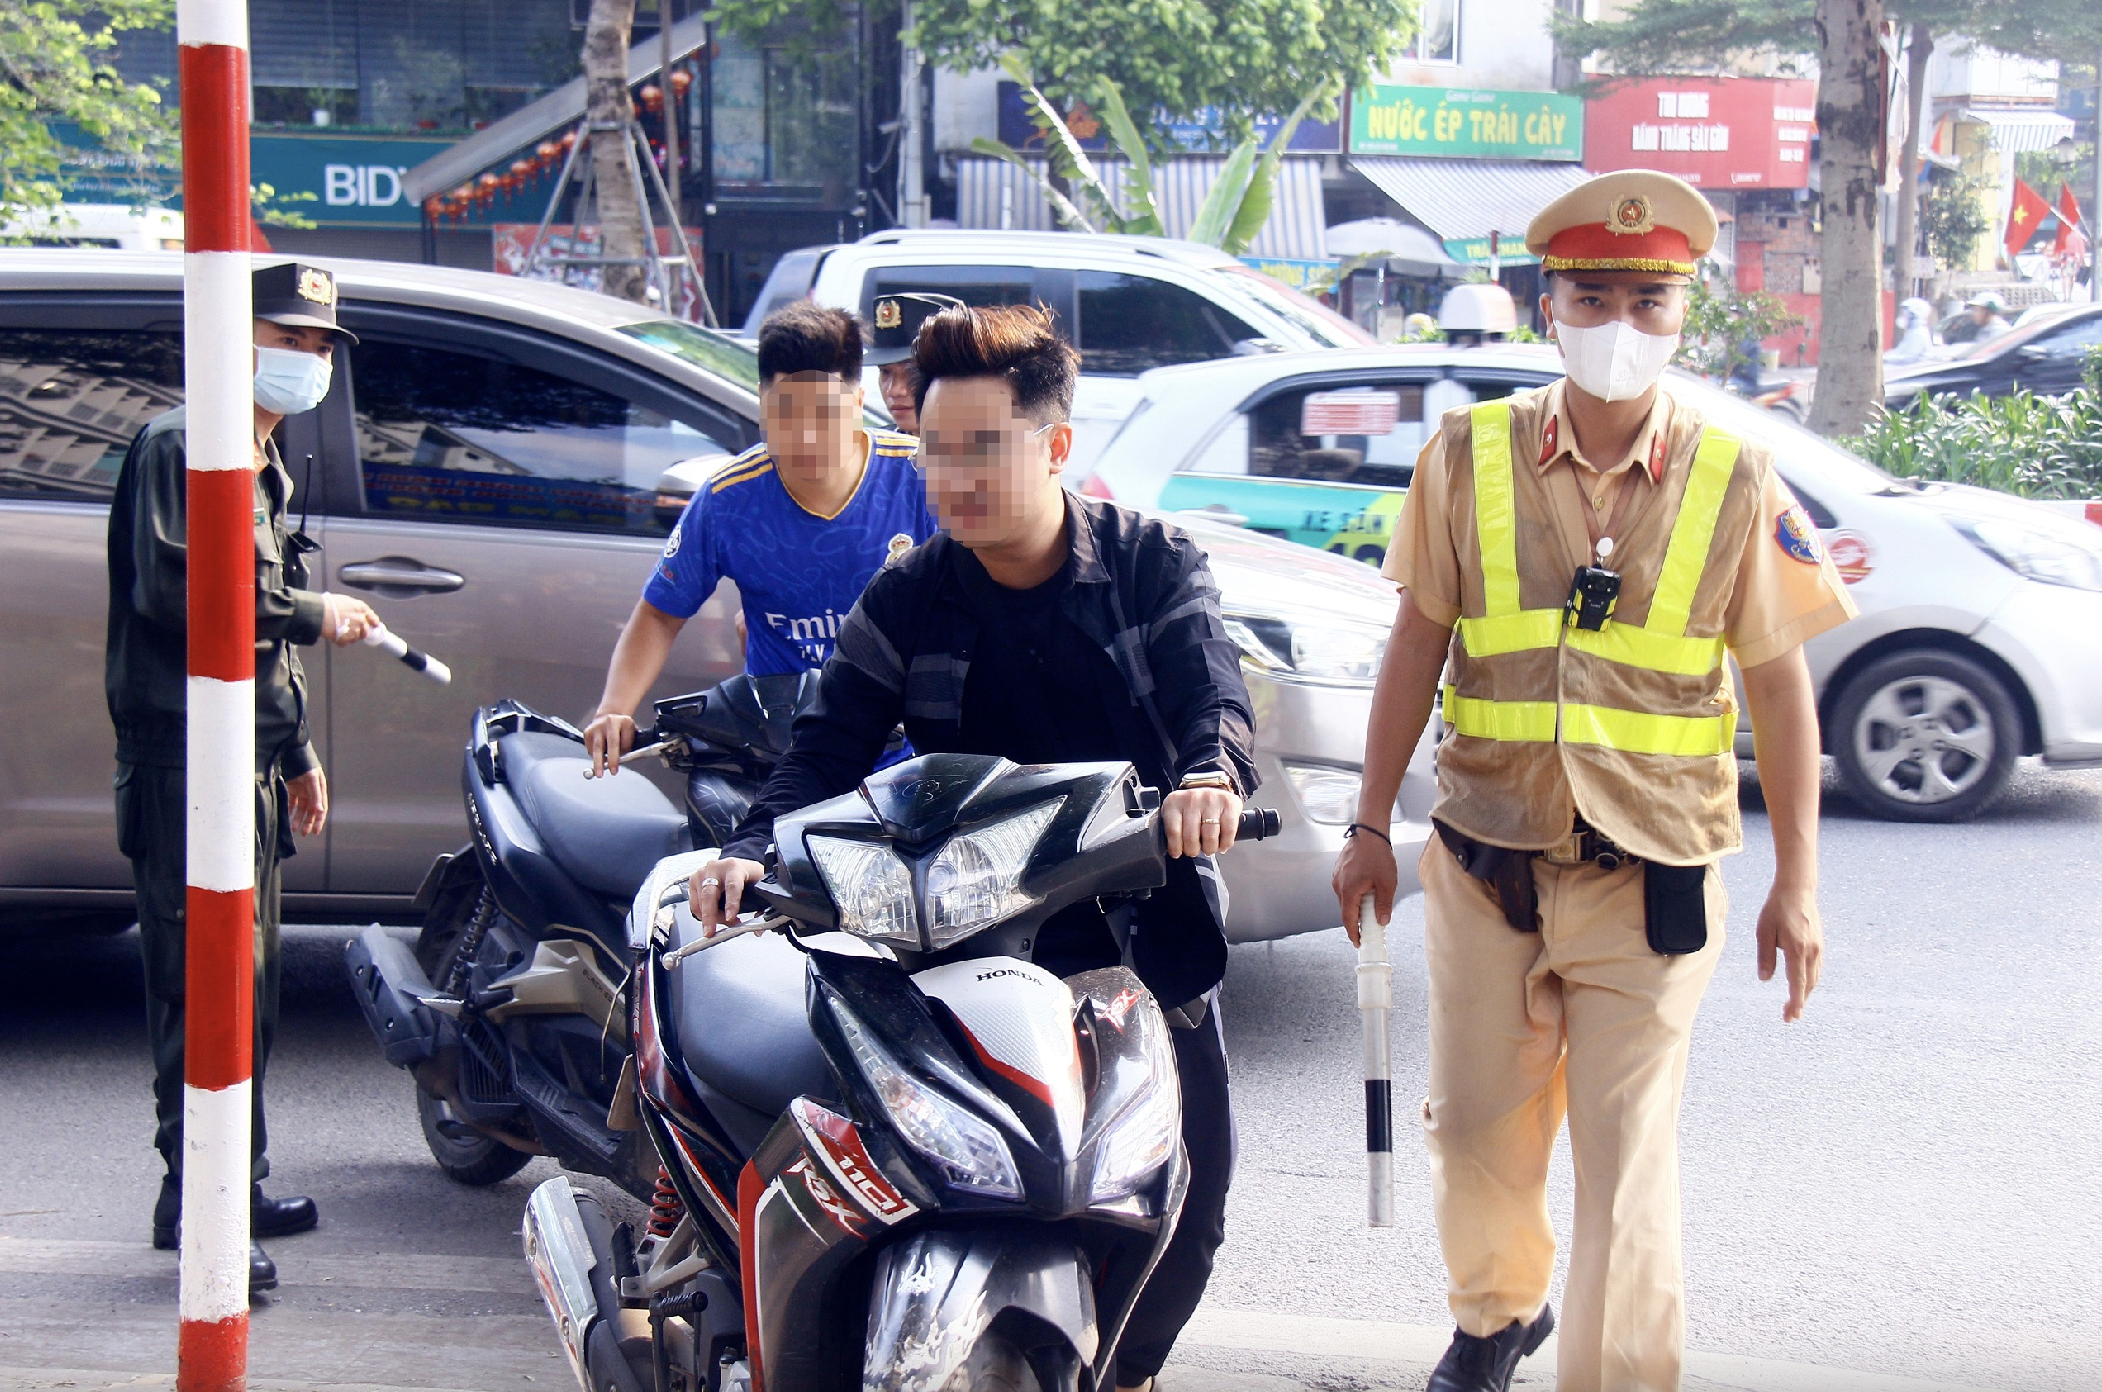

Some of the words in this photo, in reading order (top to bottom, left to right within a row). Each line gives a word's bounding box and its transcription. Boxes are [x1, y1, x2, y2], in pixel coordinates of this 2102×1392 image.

[1368, 97, 1428, 141] NƯỚC
[1434, 99, 1463, 142] ÉP
[1468, 102, 1519, 144] TRÁI
[1524, 103, 1567, 145] CÂY
[325, 163, 408, 207] BID
[976, 969, 1044, 987] HONDA
